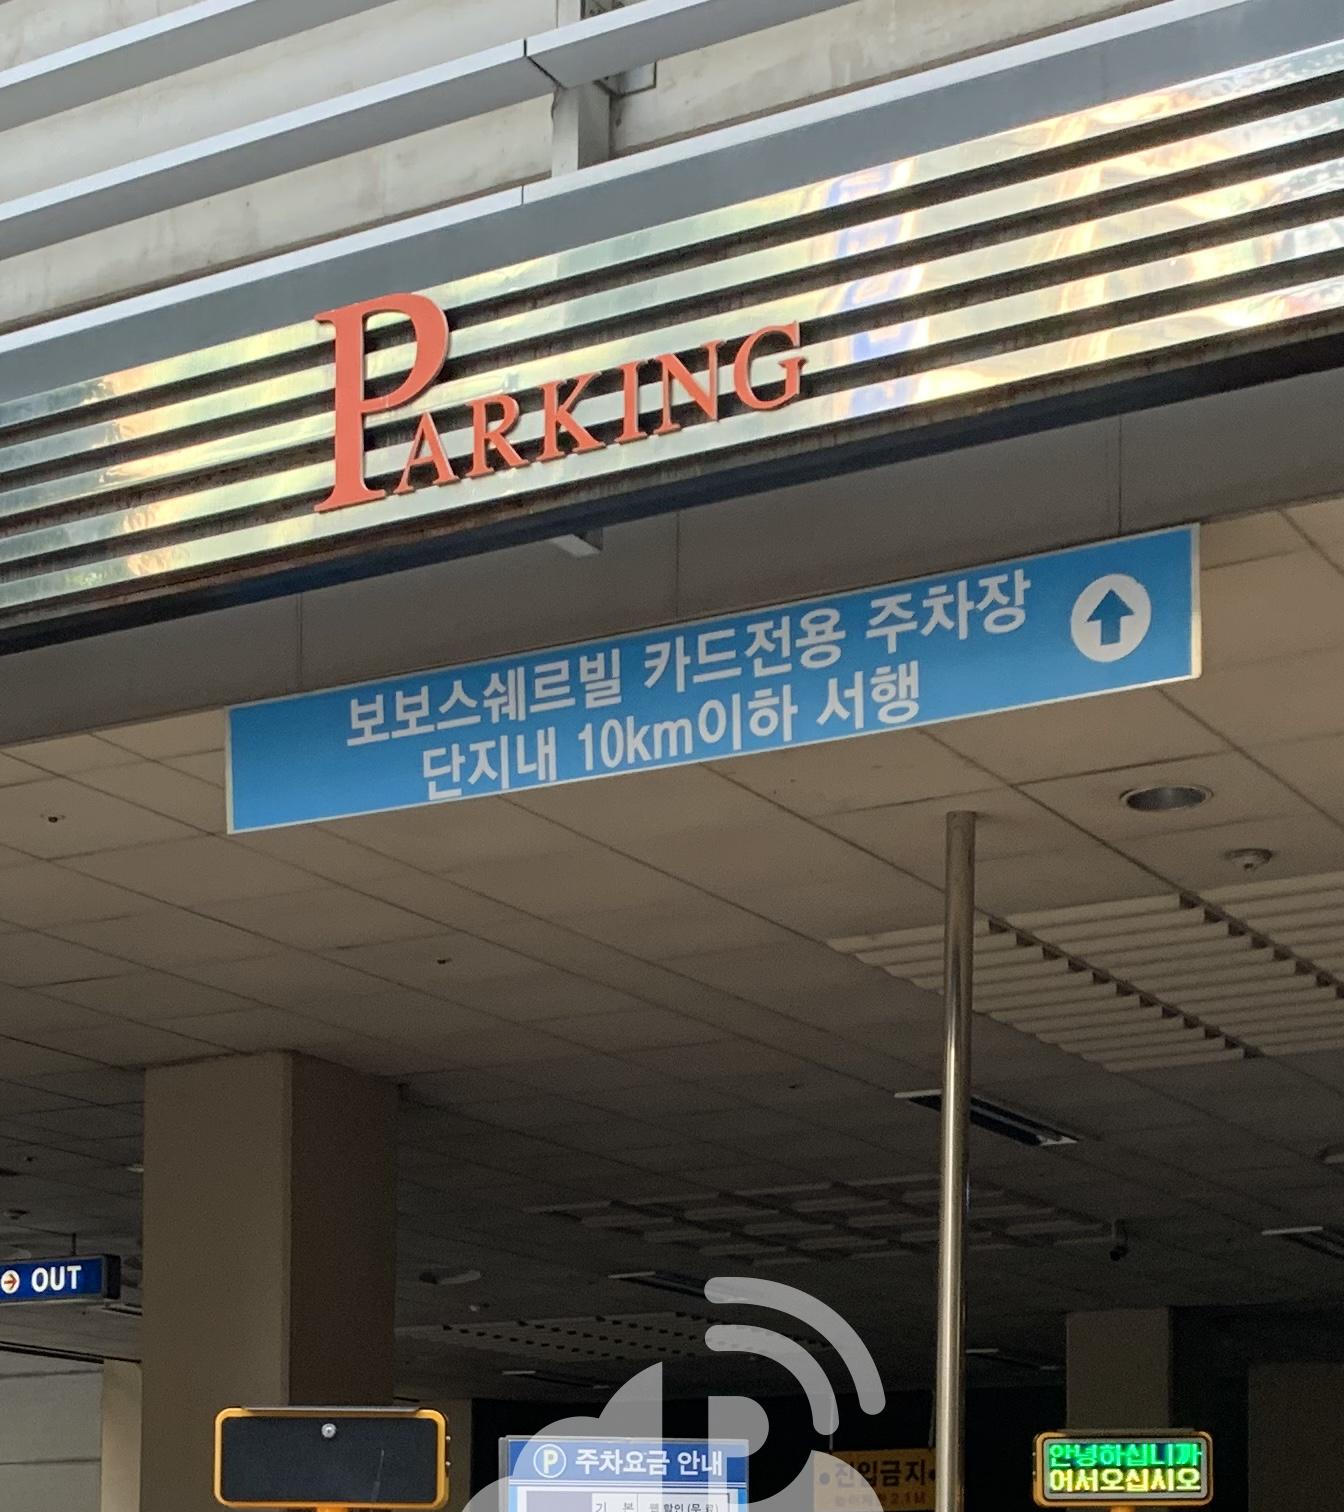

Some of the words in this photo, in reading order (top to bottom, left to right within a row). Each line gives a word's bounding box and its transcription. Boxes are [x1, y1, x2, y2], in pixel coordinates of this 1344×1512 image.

[312, 293, 808, 514] PARKING
[346, 647, 623, 747] 보보스쉐르빌
[643, 608, 846, 693] 카드전용
[864, 569, 1032, 652] 주차장
[420, 727, 559, 803] 단지내
[577, 688, 798, 771] 10km이하
[817, 660, 922, 731] 서행
[31, 1265, 82, 1293] OUT
[575, 1449, 670, 1475] 주차요금
[677, 1450, 723, 1476] 안내
[1049, 1443, 1202, 1467] 안녕하십니까
[835, 1459, 925, 1488] 진입금지
[1049, 1468, 1201, 1493] 어서오십시오
